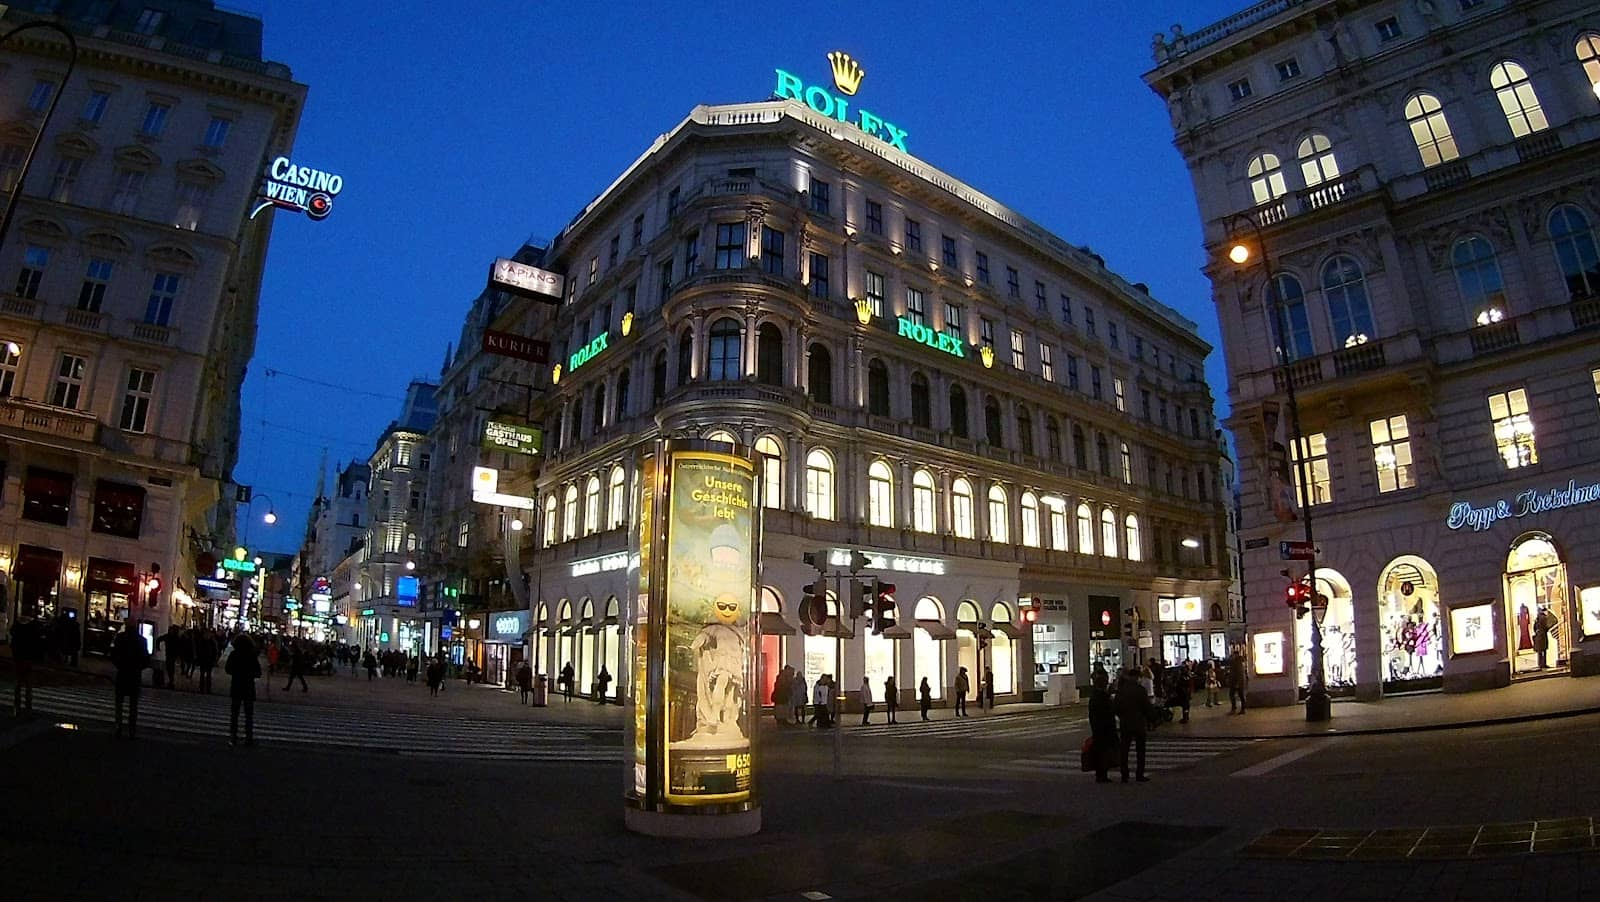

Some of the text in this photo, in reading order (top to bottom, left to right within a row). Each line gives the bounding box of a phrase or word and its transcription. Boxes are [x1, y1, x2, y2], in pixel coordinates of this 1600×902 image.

[774, 68, 911, 154] ROLEX
[271, 157, 343, 195] CASINO
[266, 181, 308, 206] WIEN
[501, 263, 557, 285] VAPIANO
[488, 335, 544, 357] KURIER
[897, 317, 965, 358] ROLEX
[569, 331, 609, 373] ROLEX
[486, 428, 532, 443] GASTHAUS
[495, 437, 519, 448] OPER
[704, 475, 743, 493] Unsere
[691, 489, 749, 509] Geschichte
[713, 506, 735, 520] lebt
[1447, 501, 1496, 532] Popp
[1496, 500, 1512, 519] &
[736, 753, 751, 769] 650
